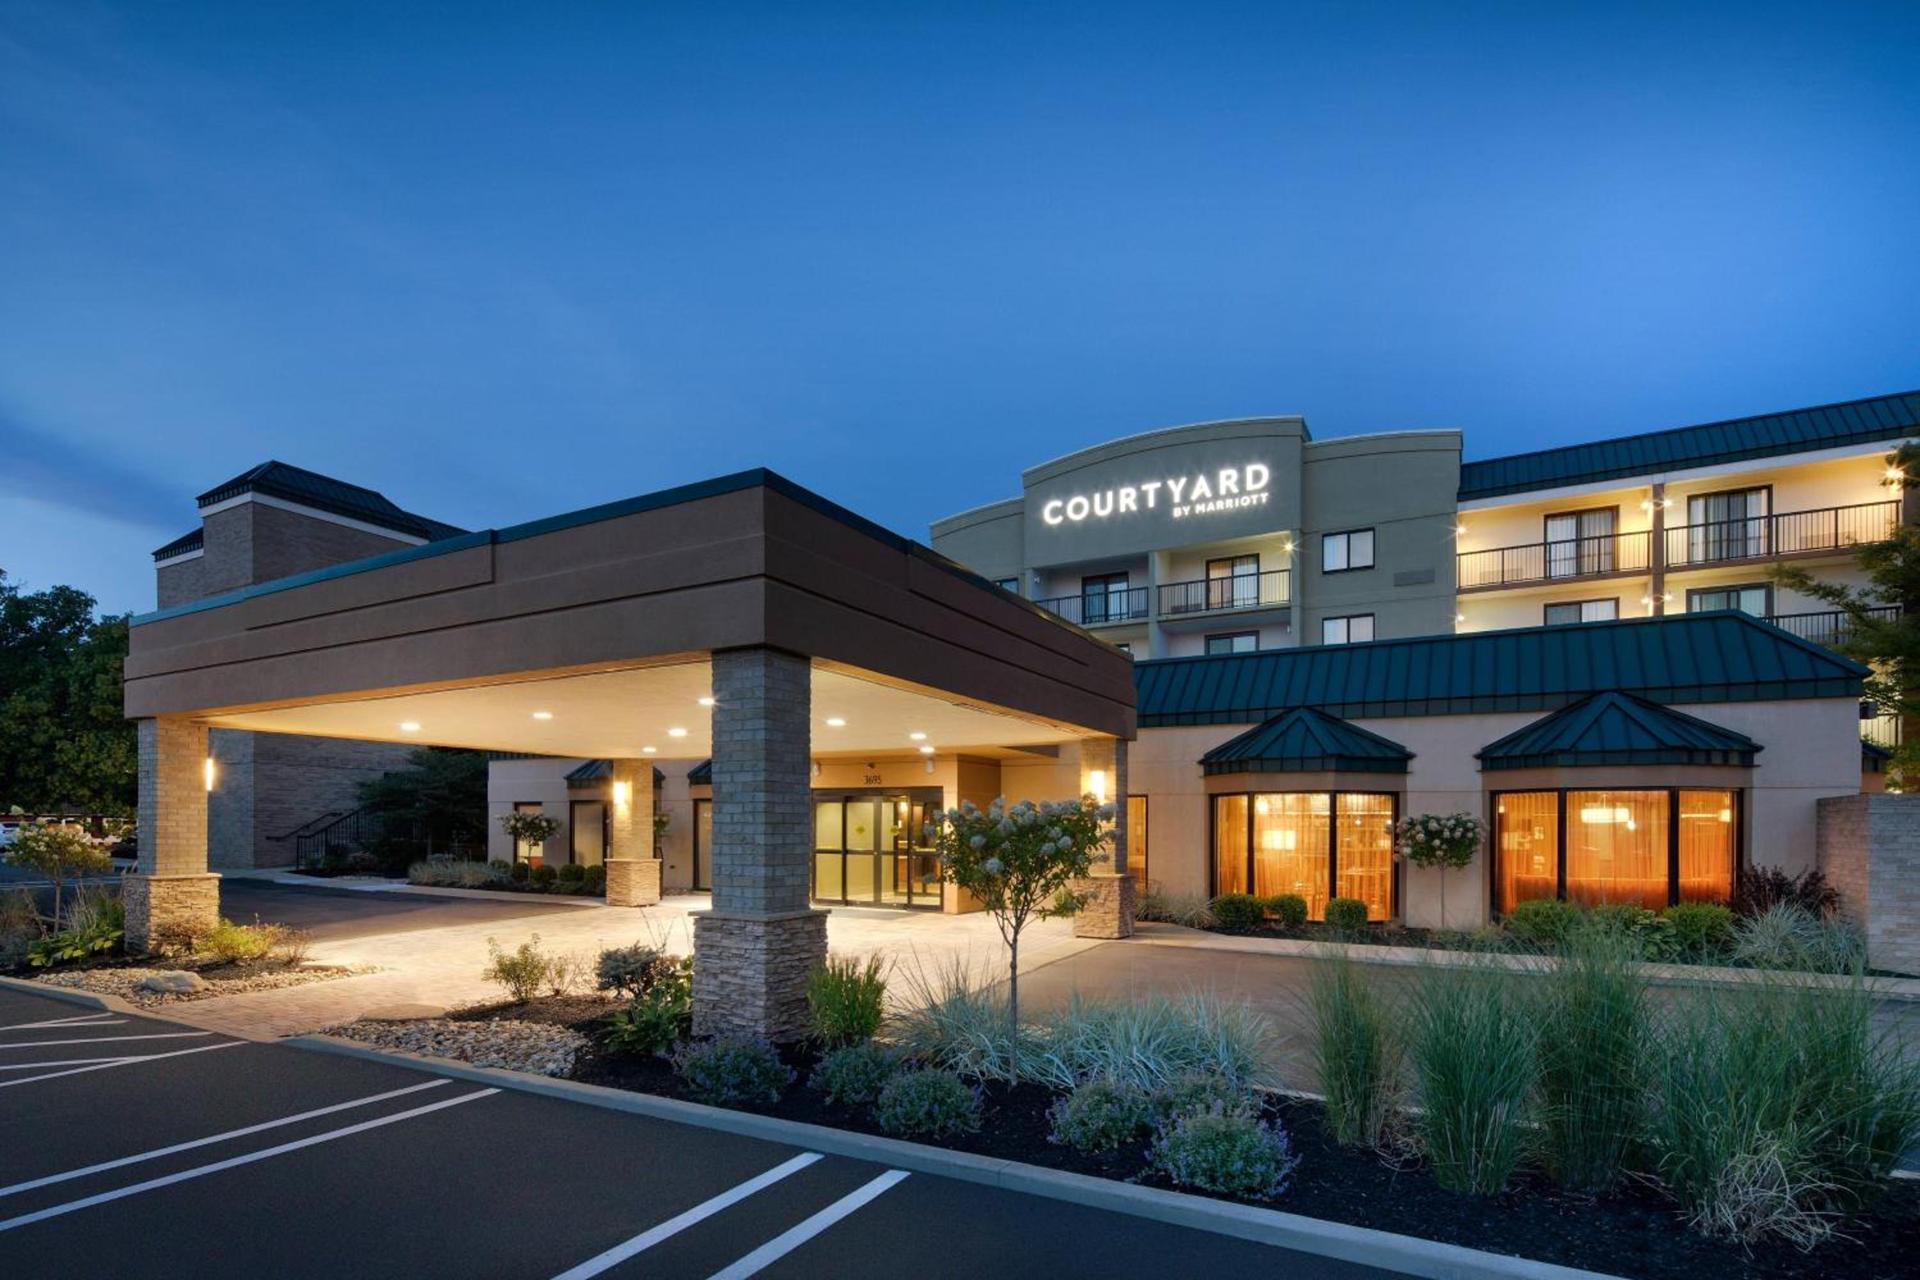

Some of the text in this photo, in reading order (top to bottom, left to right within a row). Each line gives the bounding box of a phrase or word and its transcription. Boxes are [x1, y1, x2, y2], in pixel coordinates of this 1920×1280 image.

[1042, 463, 1271, 525] COURTYARD
[1172, 491, 1270, 519] BY MARRIOTT
